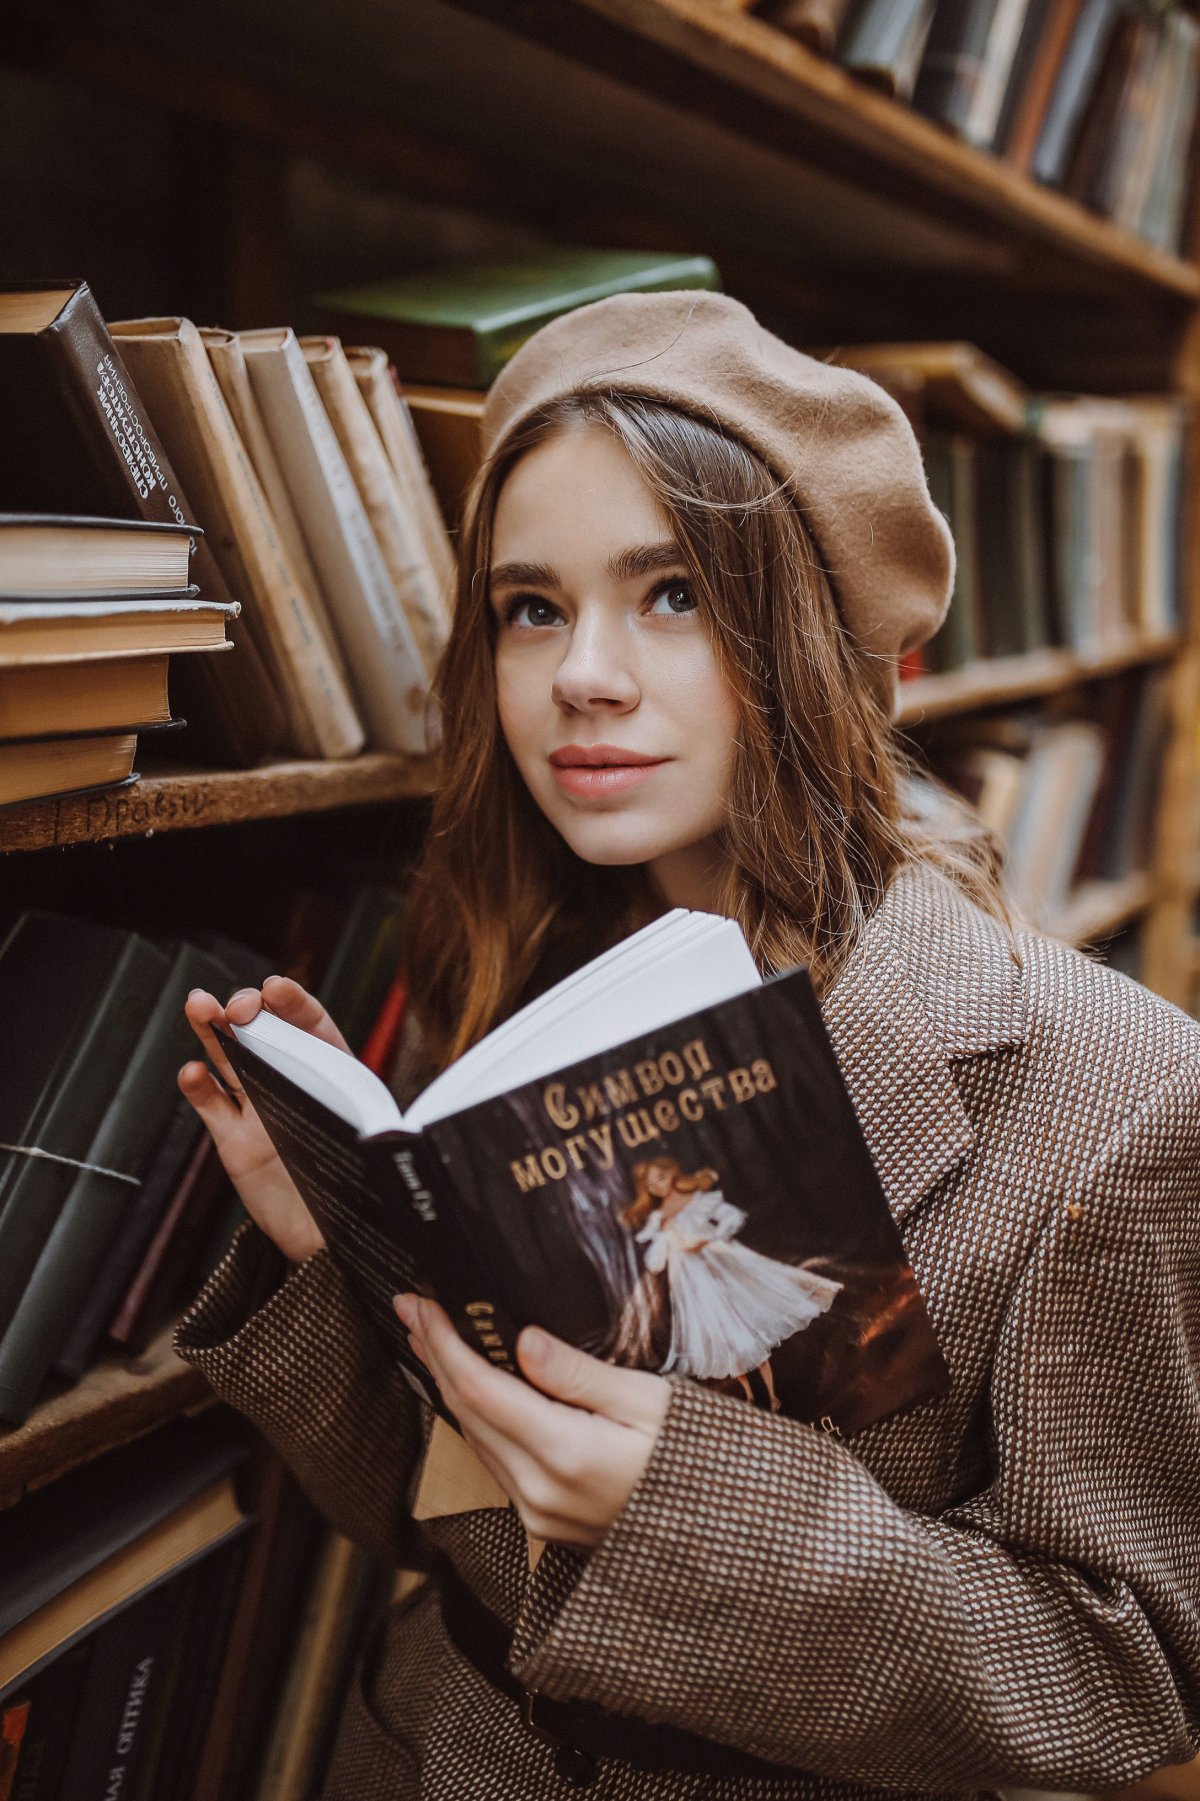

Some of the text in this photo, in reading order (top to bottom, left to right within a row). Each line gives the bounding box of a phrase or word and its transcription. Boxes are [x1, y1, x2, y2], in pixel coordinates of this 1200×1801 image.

[97, 361, 157, 491] КОНСТРУКТОРА
[97, 387, 149, 499] СПРАВОЧНИК
[104, 354, 168, 490] ПРИБОРОСТРОЕНИЯ
[509, 1057, 778, 1194] могущества
[543, 1038, 713, 1131] Символ
[116, 1655, 155, 1755] ОПТИКА
